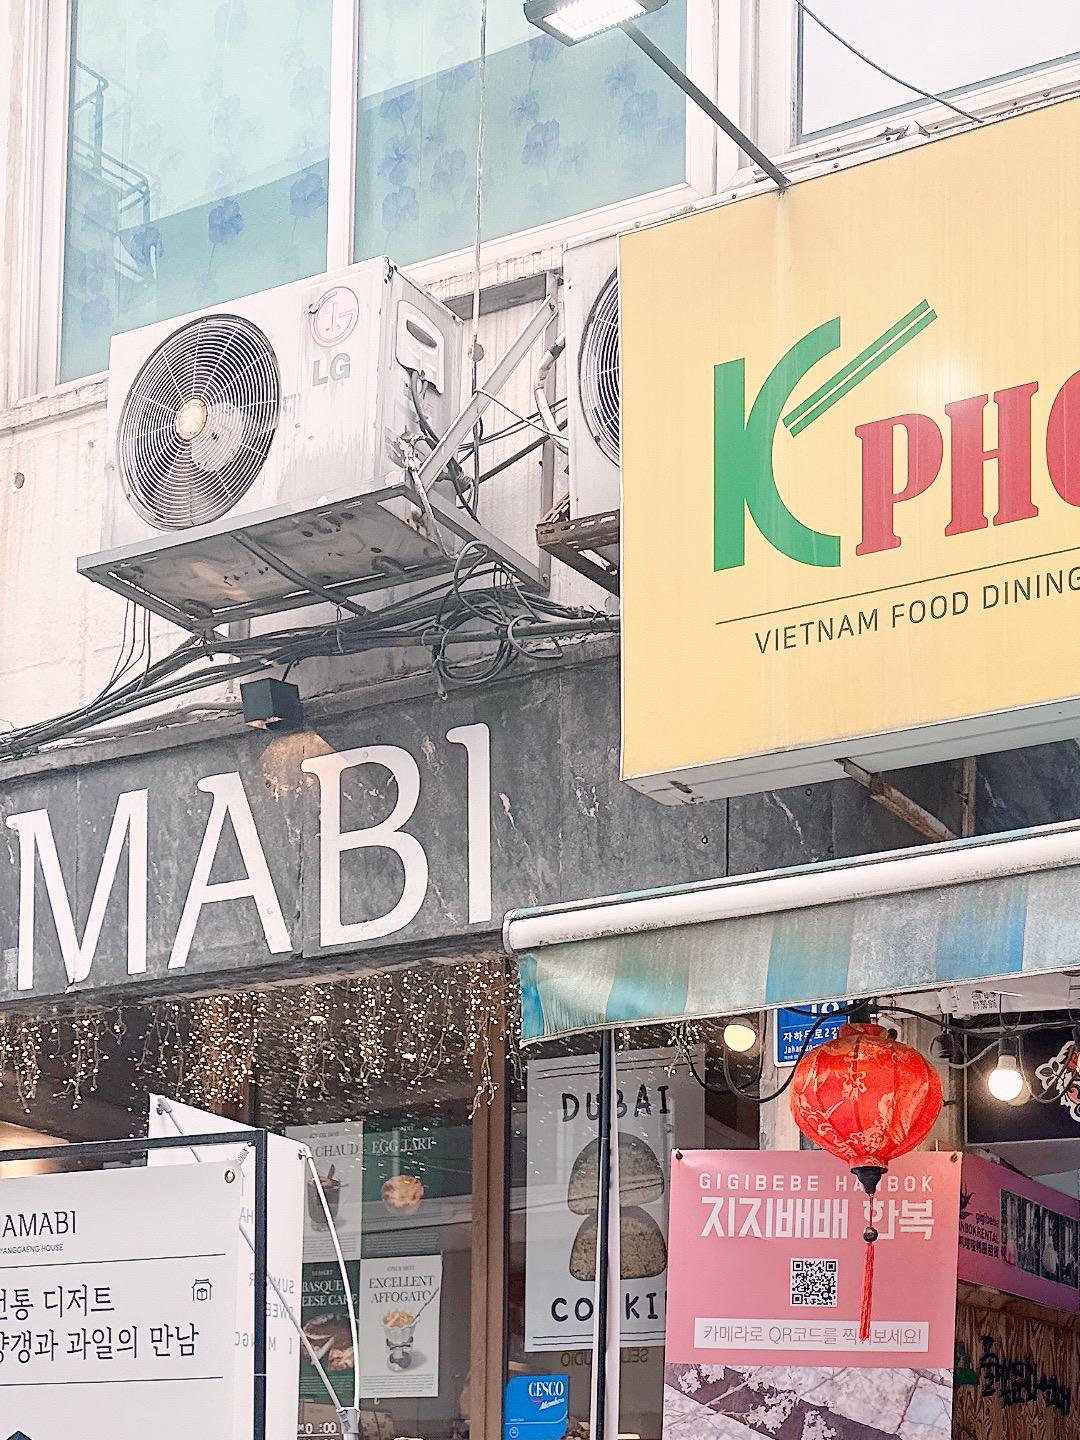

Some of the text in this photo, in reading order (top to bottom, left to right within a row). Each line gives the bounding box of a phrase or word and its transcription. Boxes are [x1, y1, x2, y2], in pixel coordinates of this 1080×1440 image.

[312, 359, 351, 386] LG
[754, 608, 880, 655] VIETNAM
[891, 591, 969, 629] FOOD
[699, 1173, 819, 1192] GIGIBEBE
[2, 1211, 76, 1237] AMABI
[701, 1197, 849, 1239] 지지배배
[369, 1275, 435, 1289] EXCELLENT
[43, 1284, 114, 1318] 디저트
[67, 1326, 137, 1360] 과일의
[150, 1323, 199, 1357] 만남
[703, 1324, 763, 1344] 카메라로
[768, 1325, 838, 1346] QR코드를
[528, 1381, 564, 1397] CESCO
